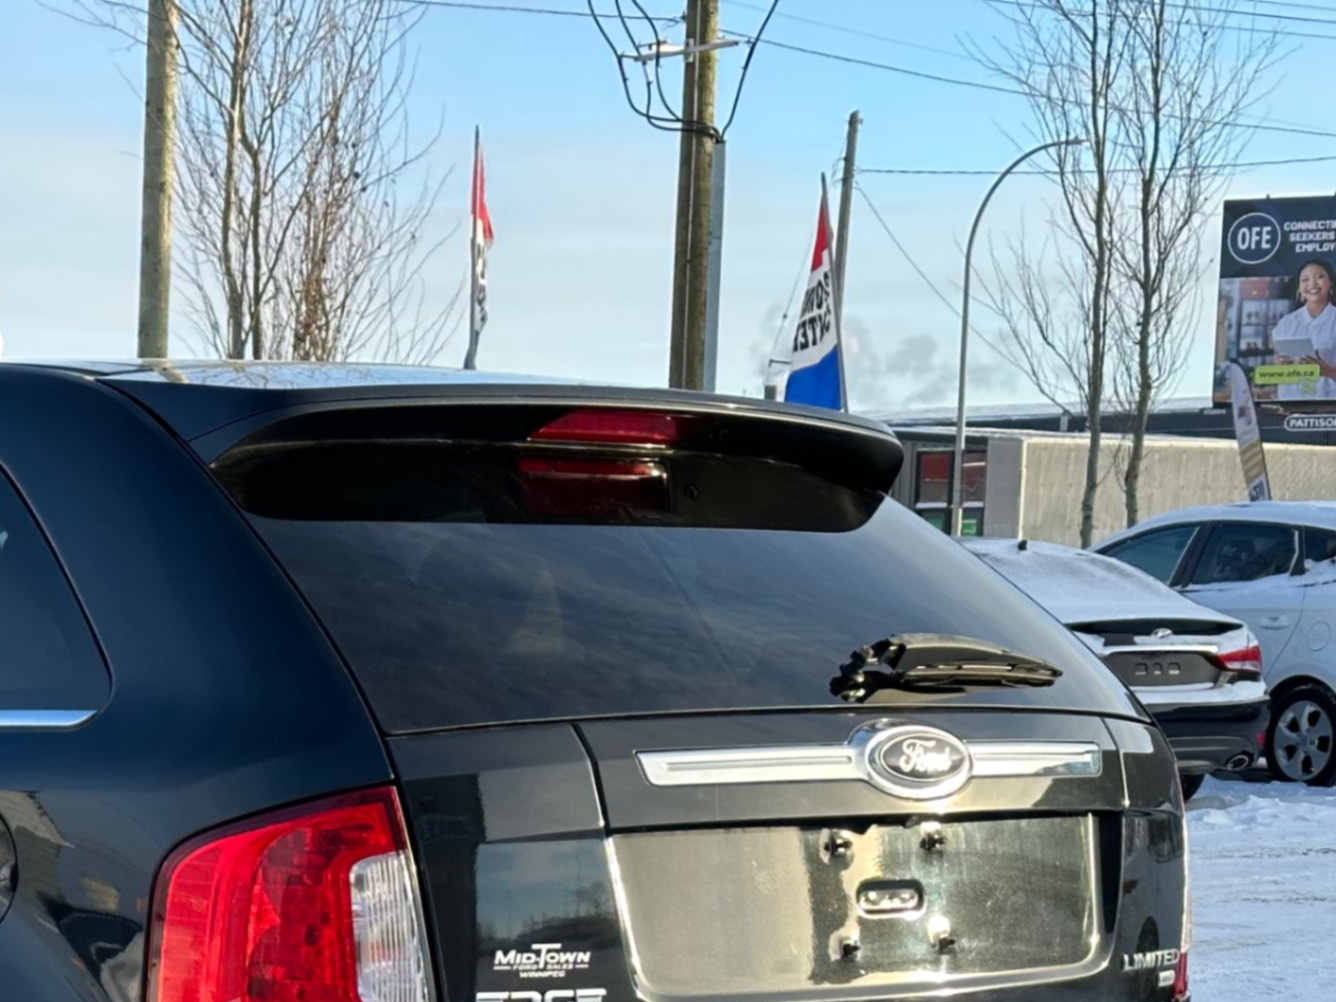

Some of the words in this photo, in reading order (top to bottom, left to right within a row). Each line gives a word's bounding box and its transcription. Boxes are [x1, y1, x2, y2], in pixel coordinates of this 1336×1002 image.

[1237, 226, 1272, 250] OFE
[1289, 231, 1335, 242] SEEKERS
[1295, 242, 1336, 252] EMPLOY
[1259, 368, 1314, 378] www.ofe.ca
[899, 739, 953, 772] Ford
[1123, 948, 1180, 972] LIMITED
[519, 970, 566, 978] WINNIPEG
